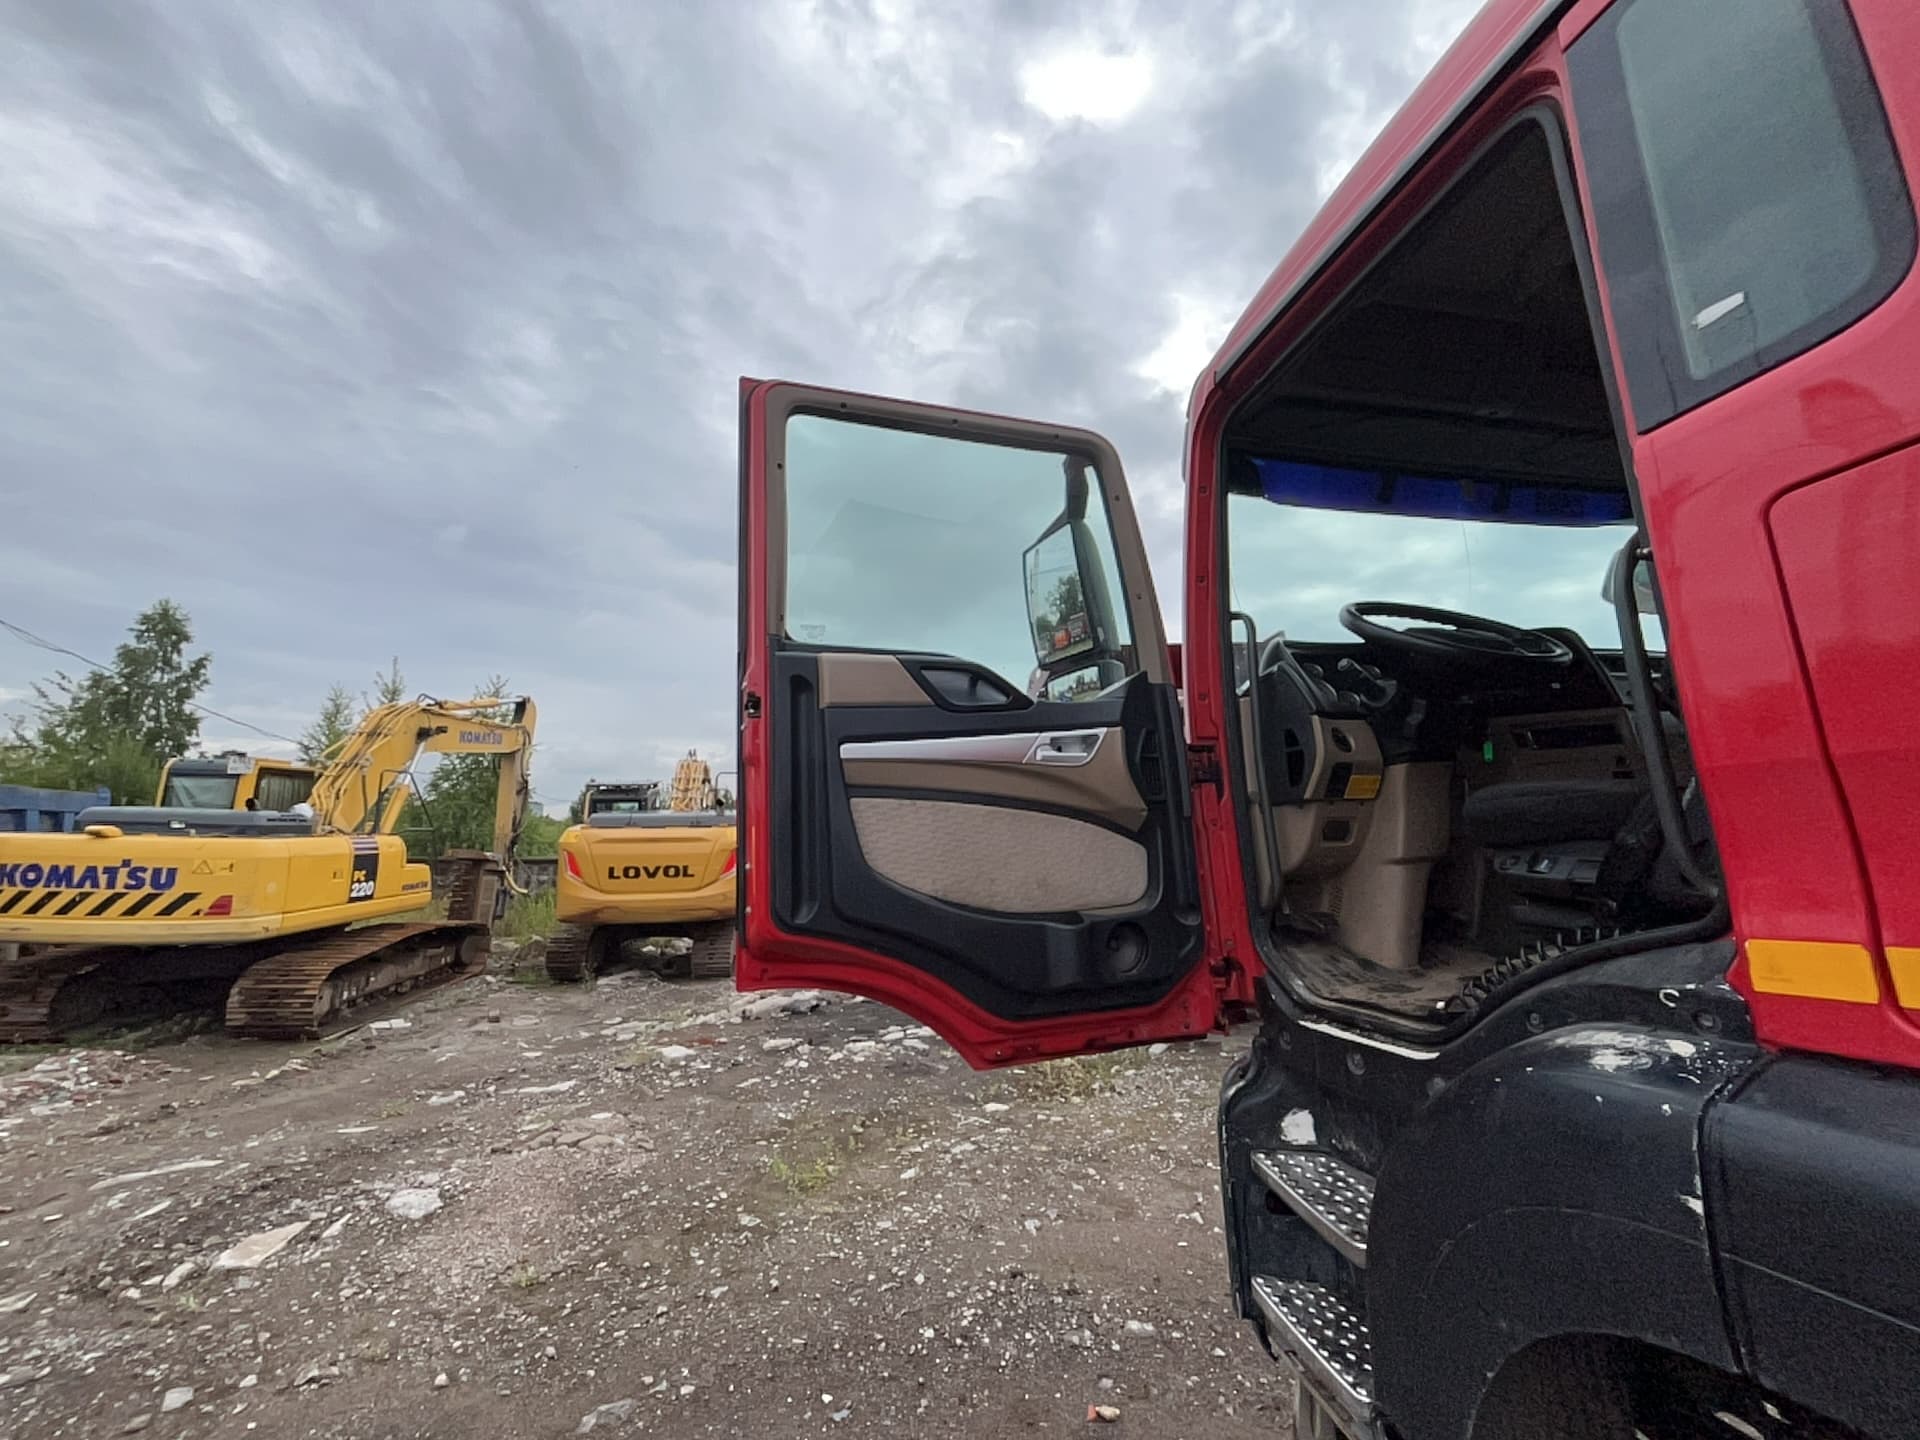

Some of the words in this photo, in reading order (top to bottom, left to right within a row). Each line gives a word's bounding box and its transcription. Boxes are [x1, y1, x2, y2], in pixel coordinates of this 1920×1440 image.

[0, 859, 177, 891] KOMATSU
[608, 865, 695, 880] LOVOL
[350, 881, 375, 898] 220
